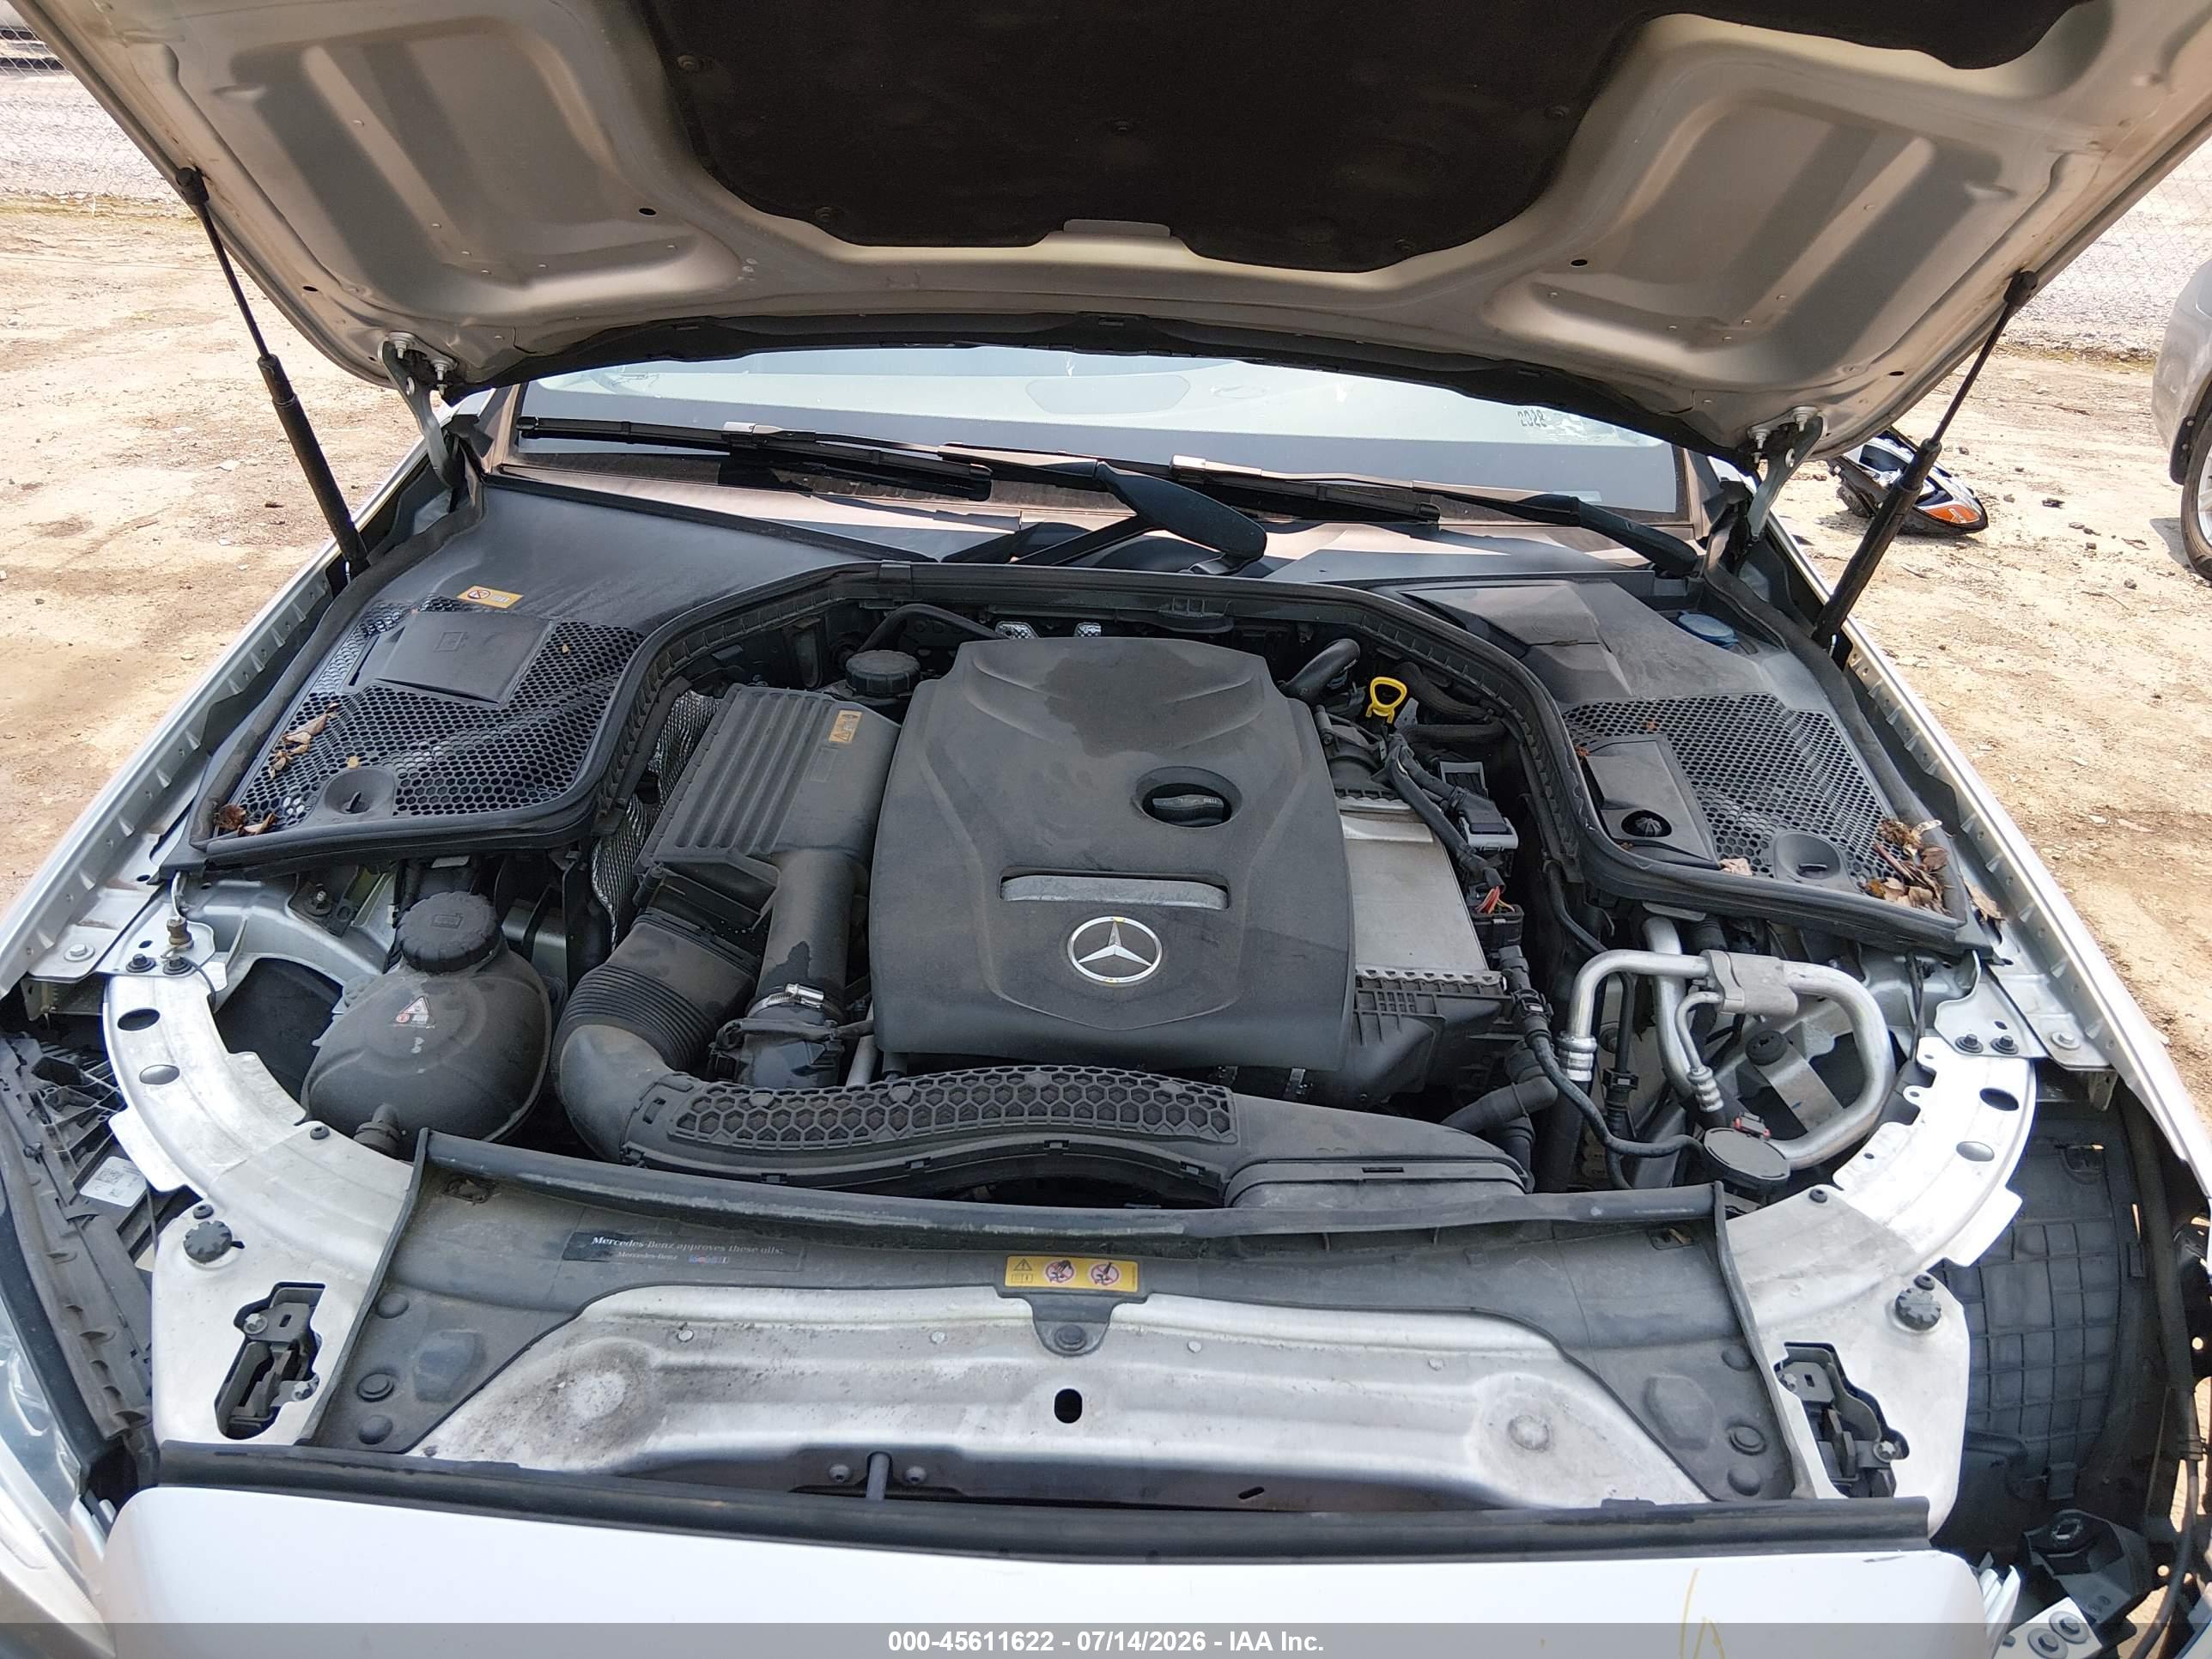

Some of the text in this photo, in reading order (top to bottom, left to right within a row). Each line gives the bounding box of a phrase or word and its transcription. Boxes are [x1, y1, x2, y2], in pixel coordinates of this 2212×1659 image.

[591, 1237, 674, 1250] Mercedes-Benz
[676, 1243, 726, 1252] approves
[728, 1244, 759, 1253] these
